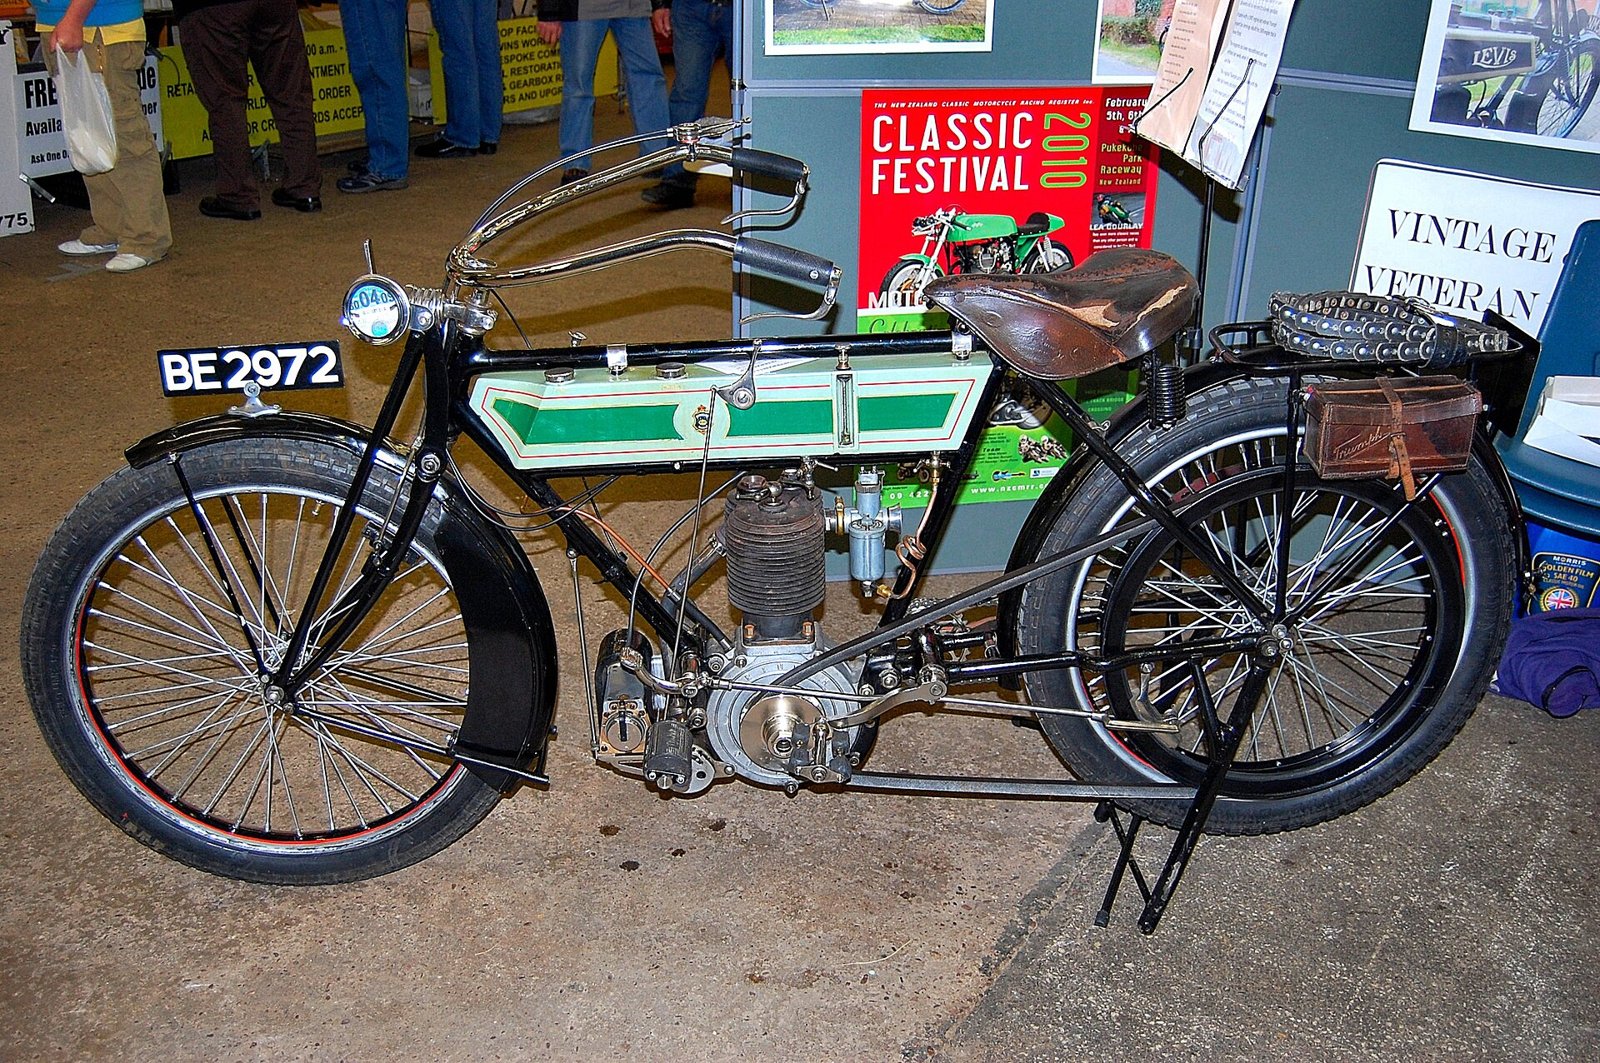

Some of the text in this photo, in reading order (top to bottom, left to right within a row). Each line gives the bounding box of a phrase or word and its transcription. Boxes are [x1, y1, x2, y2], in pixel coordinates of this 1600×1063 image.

[1471, 46, 1517, 69] LEVIS
[509, 76, 554, 90] GEARBOX
[319, 85, 351, 100] ORDER
[518, 90, 537, 102] AND
[873, 112, 1092, 188] CLASSIC 2010
[31, 154, 46, 164] Ask
[1122, 153, 1143, 163] Park
[872, 155, 1029, 195] FESTIVAL
[1100, 165, 1142, 175] Raceway
[1388, 208, 1556, 264] VINTAGE
[1364, 265, 1540, 321] VETERAN
[1333, 426, 1390, 460] Triumph
[1552, 555, 1587, 566] MORRIS
[1553, 572, 1567, 580] SAE
[1574, 568, 1595, 578] FILM
